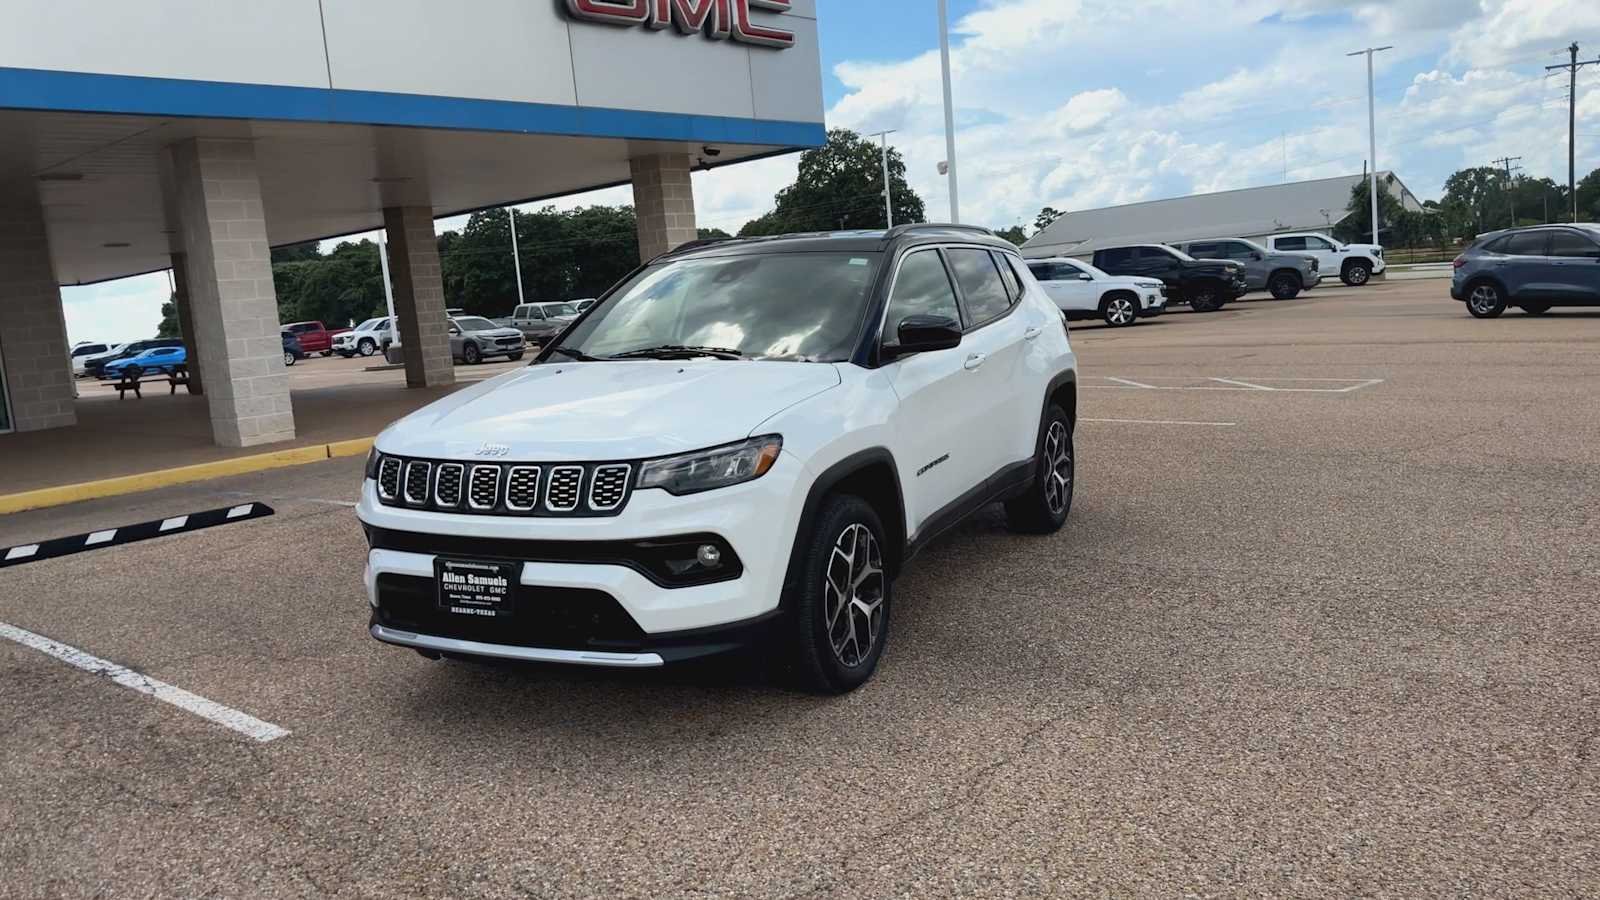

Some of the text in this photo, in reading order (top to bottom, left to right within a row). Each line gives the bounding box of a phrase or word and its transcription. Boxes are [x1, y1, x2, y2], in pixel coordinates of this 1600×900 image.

[474, 440, 511, 459] Jeep
[442, 572, 507, 586] Allen Samuels
[443, 583, 507, 594] CHEVROLET GMC
